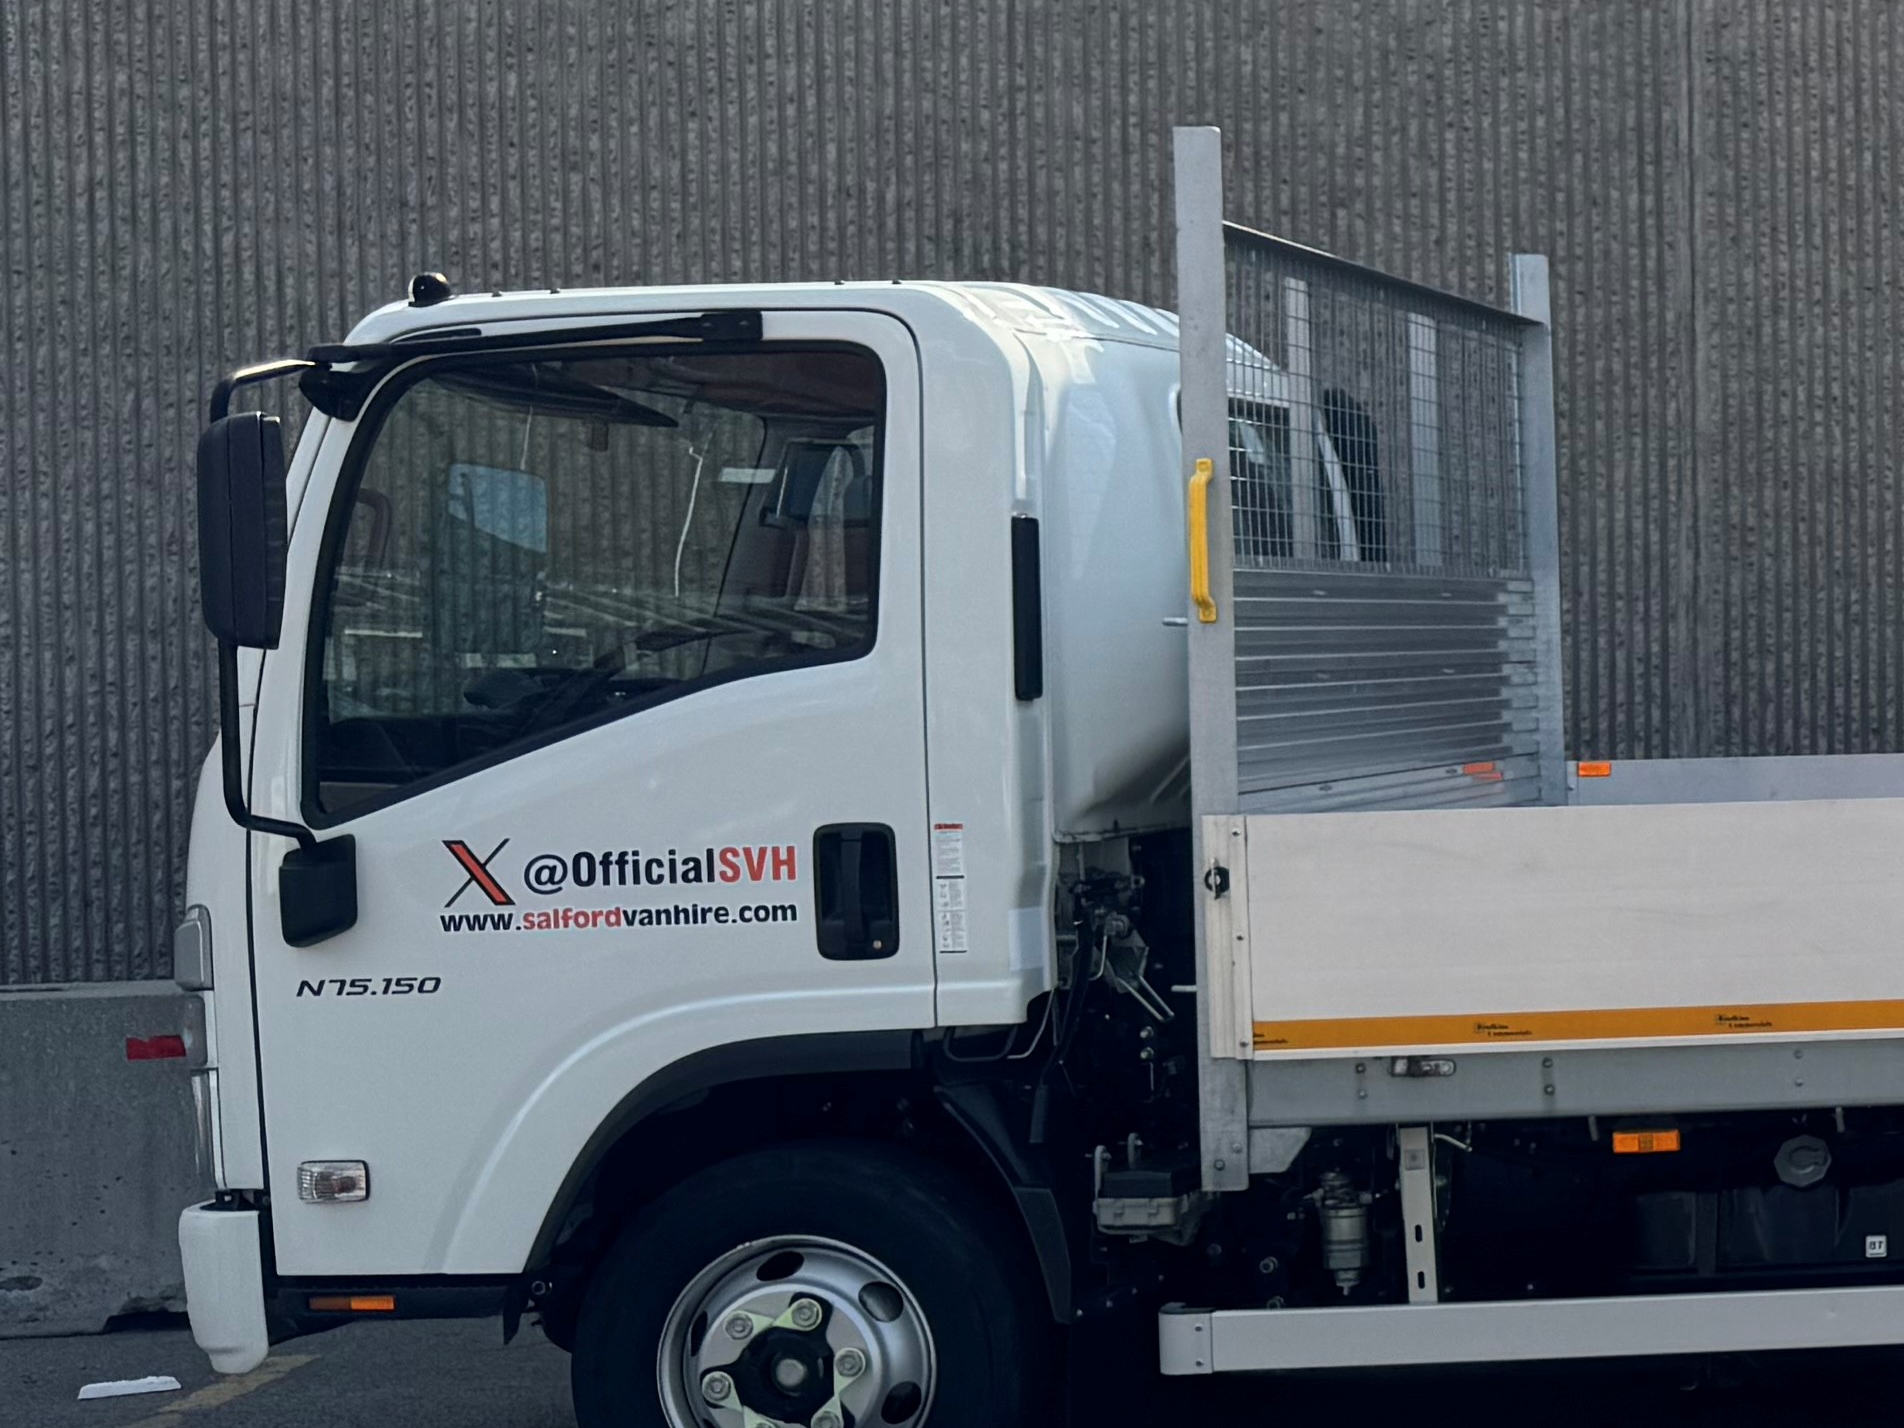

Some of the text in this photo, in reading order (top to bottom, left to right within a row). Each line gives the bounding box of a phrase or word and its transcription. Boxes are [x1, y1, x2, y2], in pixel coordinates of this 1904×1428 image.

[523, 845, 797, 895] @OfficialSVH
[440, 903, 798, 932] www.salfordvanhire.com
[296, 976, 442, 997] N75.150
